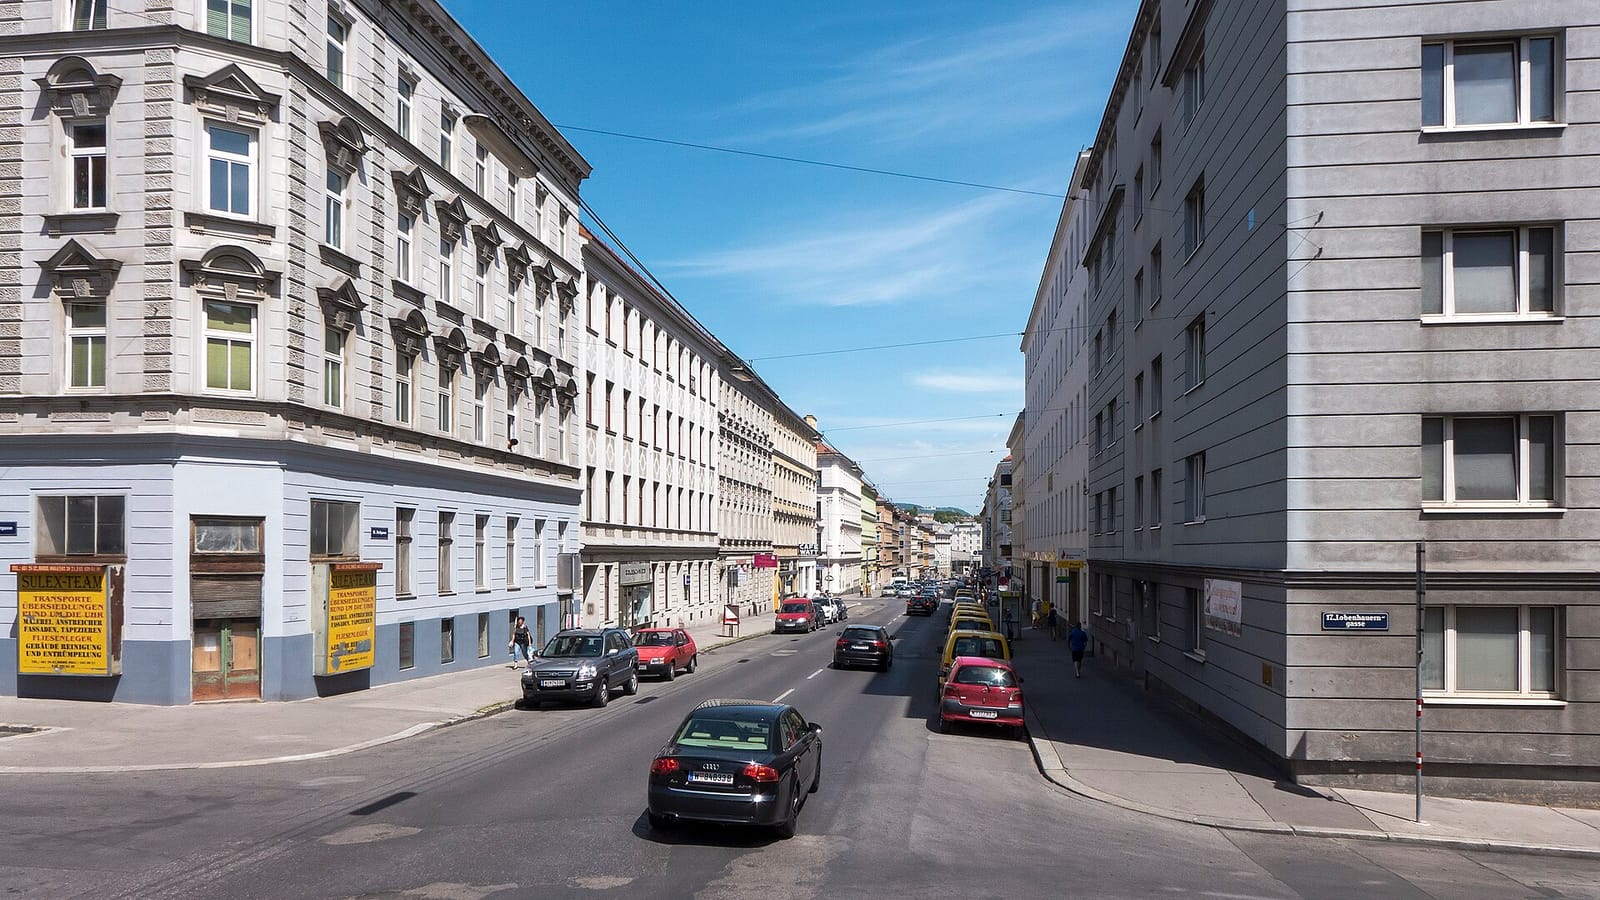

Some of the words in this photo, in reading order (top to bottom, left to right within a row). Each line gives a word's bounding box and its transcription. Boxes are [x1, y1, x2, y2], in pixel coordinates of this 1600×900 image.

[22, 575, 102, 589] SULEX-TEAM
[22, 602, 104, 611] ÜBERSIEDLUNGEN
[56, 618, 103, 626] ANSTREICHER
[61, 626, 102, 634] TAPEZIEREN
[25, 642, 60, 651] GEBÄUDE
[61, 643, 102, 651] REINIGUNG
[43, 650, 102, 658] ENTRÜMPELUNG
